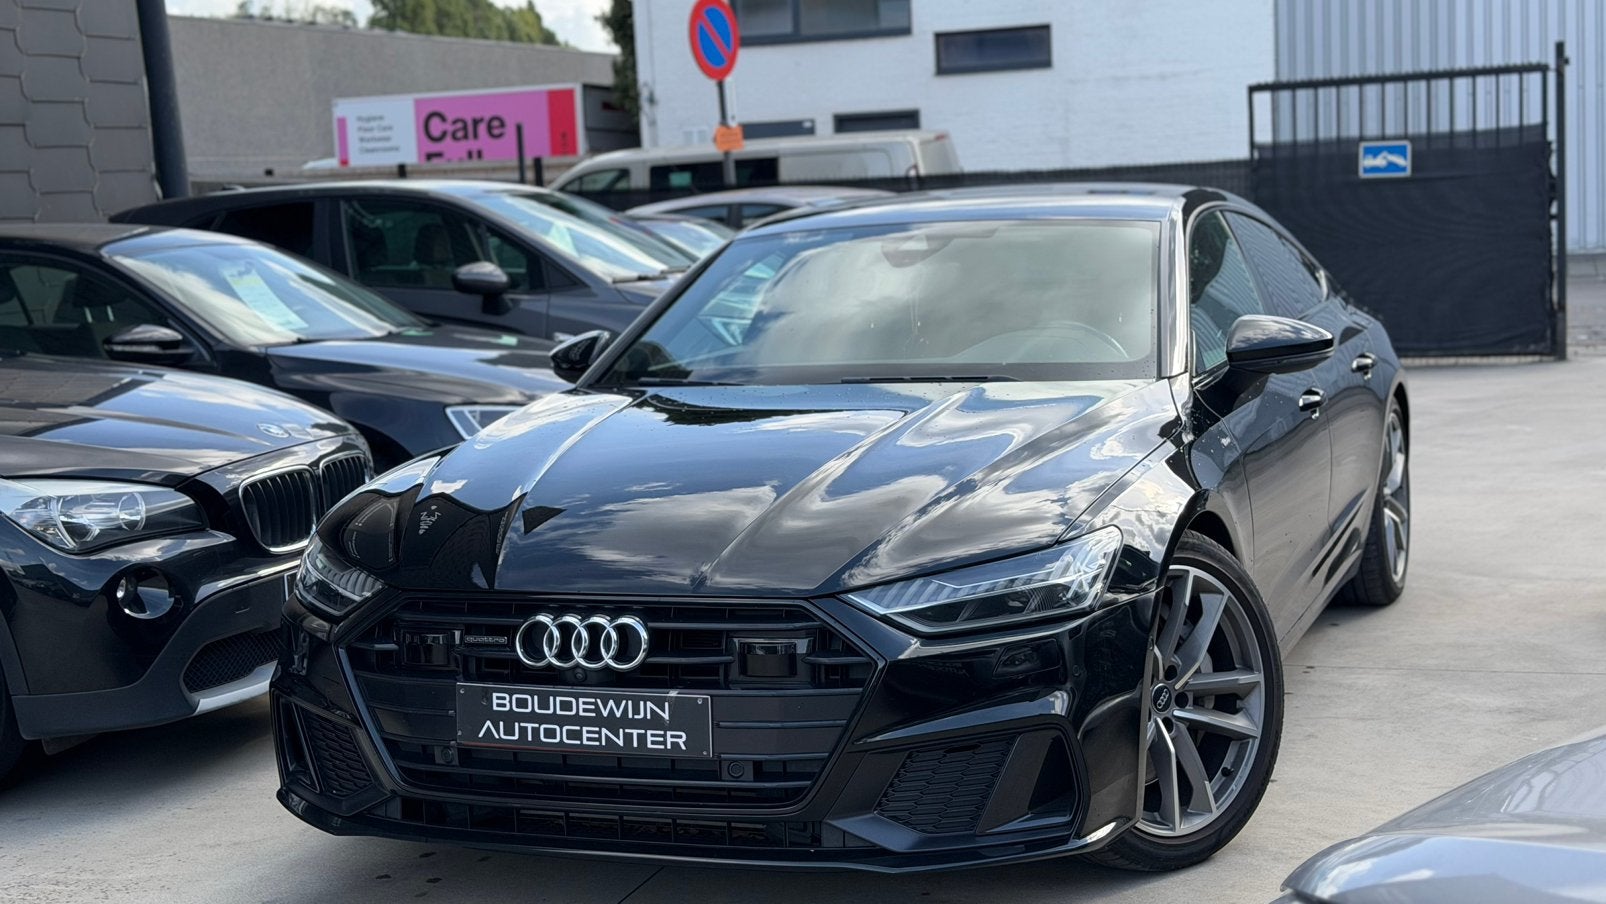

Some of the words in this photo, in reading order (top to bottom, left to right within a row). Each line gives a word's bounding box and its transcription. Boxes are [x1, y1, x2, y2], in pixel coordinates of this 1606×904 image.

[423, 111, 506, 142] Care
[465, 635, 506, 643] quattro
[492, 692, 670, 720] BOUDEWIJN
[478, 720, 687, 750] AUTOCENTER
